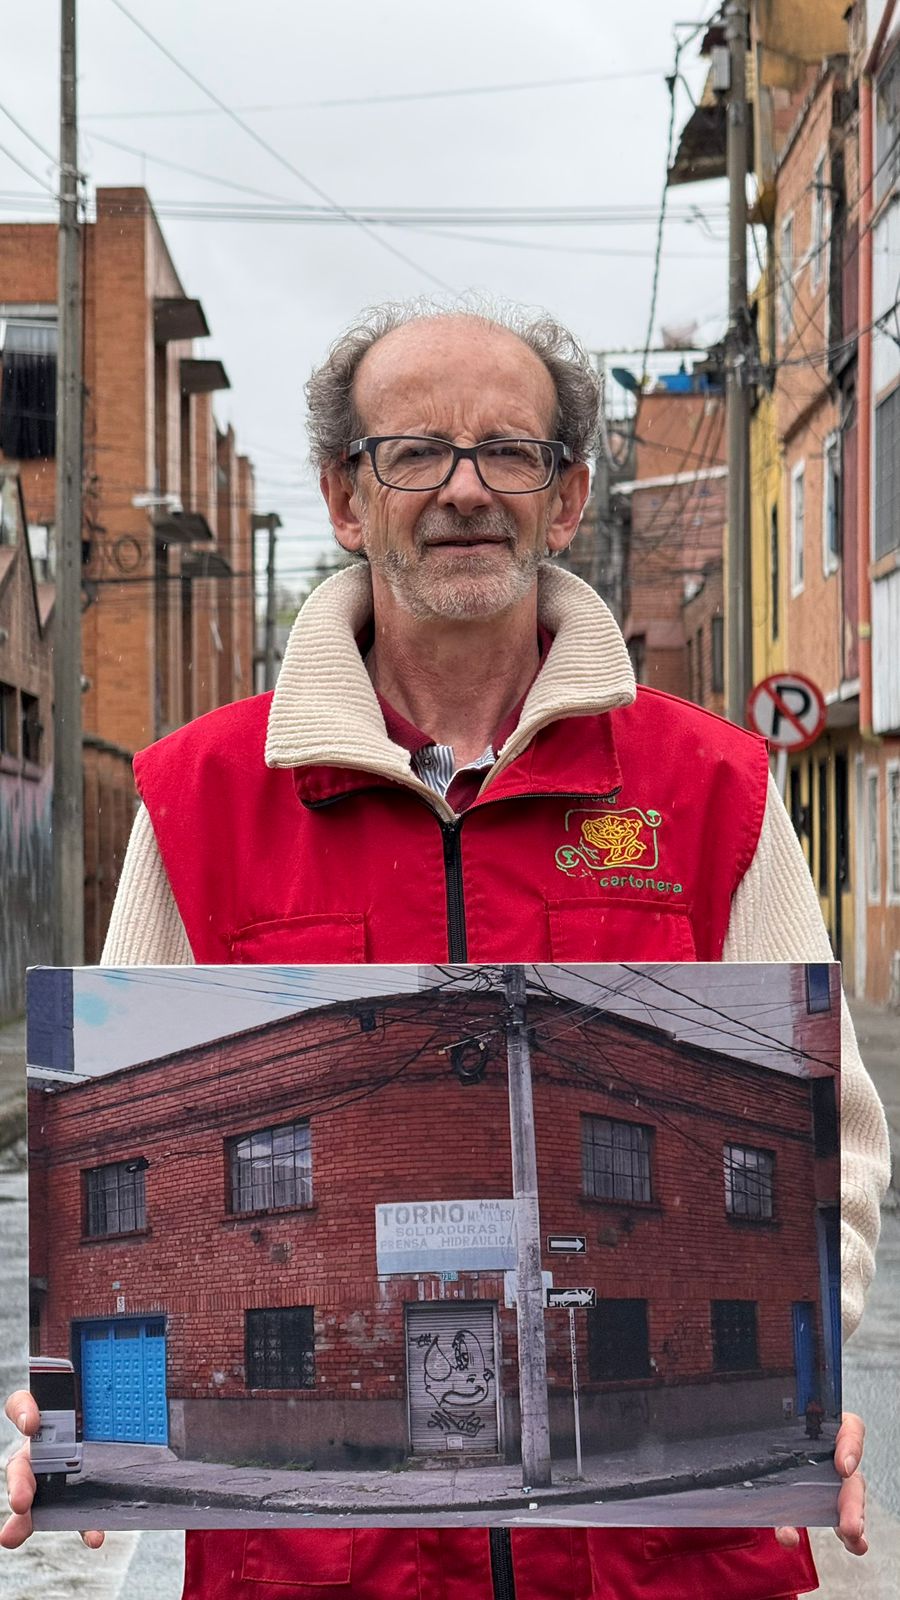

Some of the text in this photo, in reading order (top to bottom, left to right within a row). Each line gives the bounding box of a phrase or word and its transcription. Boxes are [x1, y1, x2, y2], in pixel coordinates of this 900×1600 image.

[772, 685, 811, 736] P
[600, 875, 683, 893] cartonera
[480, 1202, 500, 1210] PARA
[379, 1203, 465, 1227] TORNO
[395, 1223, 498, 1238] SOLDADURAS
[380, 1235, 513, 1250] PRENSA HIDRAULICA
